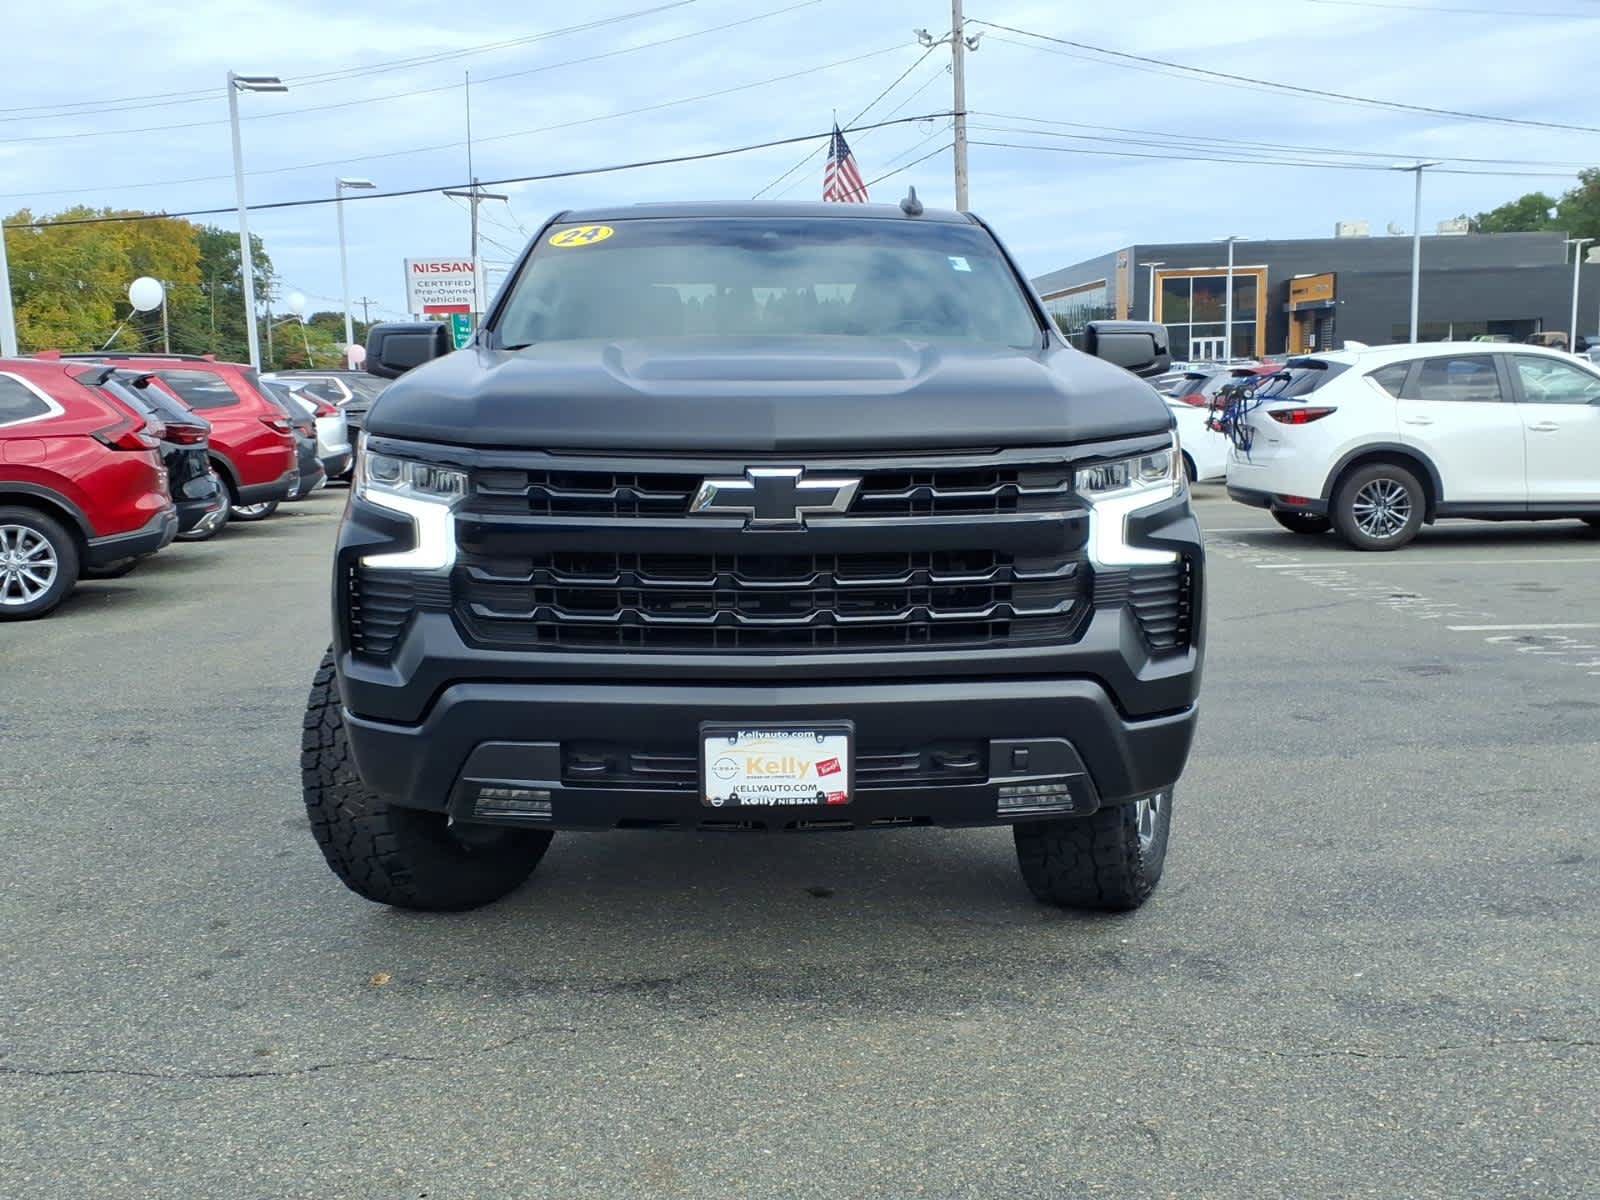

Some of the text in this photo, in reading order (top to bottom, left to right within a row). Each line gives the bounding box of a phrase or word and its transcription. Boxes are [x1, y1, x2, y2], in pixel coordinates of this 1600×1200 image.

[557, 228, 600, 244] 24
[413, 263, 475, 273] NISSAN
[737, 730, 815, 739] Kellyauto.com
[746, 756, 811, 780] Kelly
[733, 784, 817, 793] KELLYAUTO.COM
[740, 795, 777, 806] Kelly
